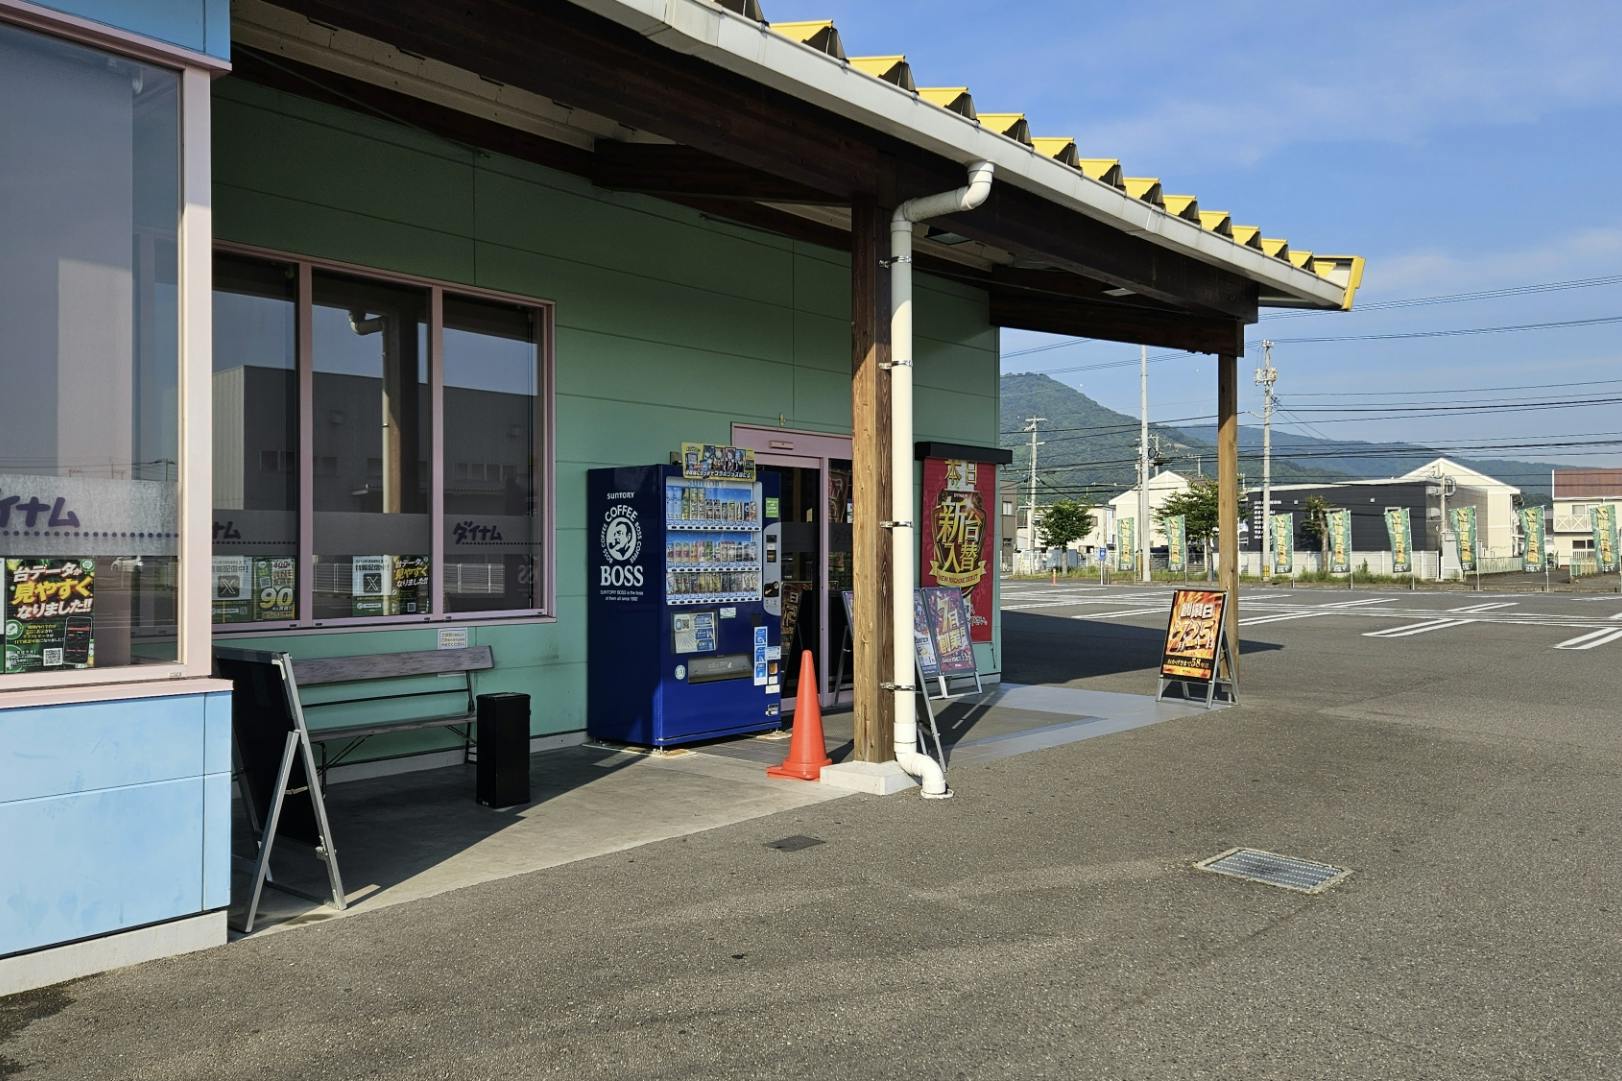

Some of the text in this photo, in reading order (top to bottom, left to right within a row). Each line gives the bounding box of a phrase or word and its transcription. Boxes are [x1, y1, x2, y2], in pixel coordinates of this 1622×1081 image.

[607, 492, 634, 500] SUNTORY
[605, 505, 638, 522] COFFEE
[937, 496, 982, 544] 新台
[453, 521, 502, 545] ダイナム
[943, 542, 978, 573] 入替
[600, 565, 644, 587] BOSS
[11, 576, 93, 605] 見やすく
[260, 588, 293, 609] 90
[16, 598, 93, 619] なりました!!
